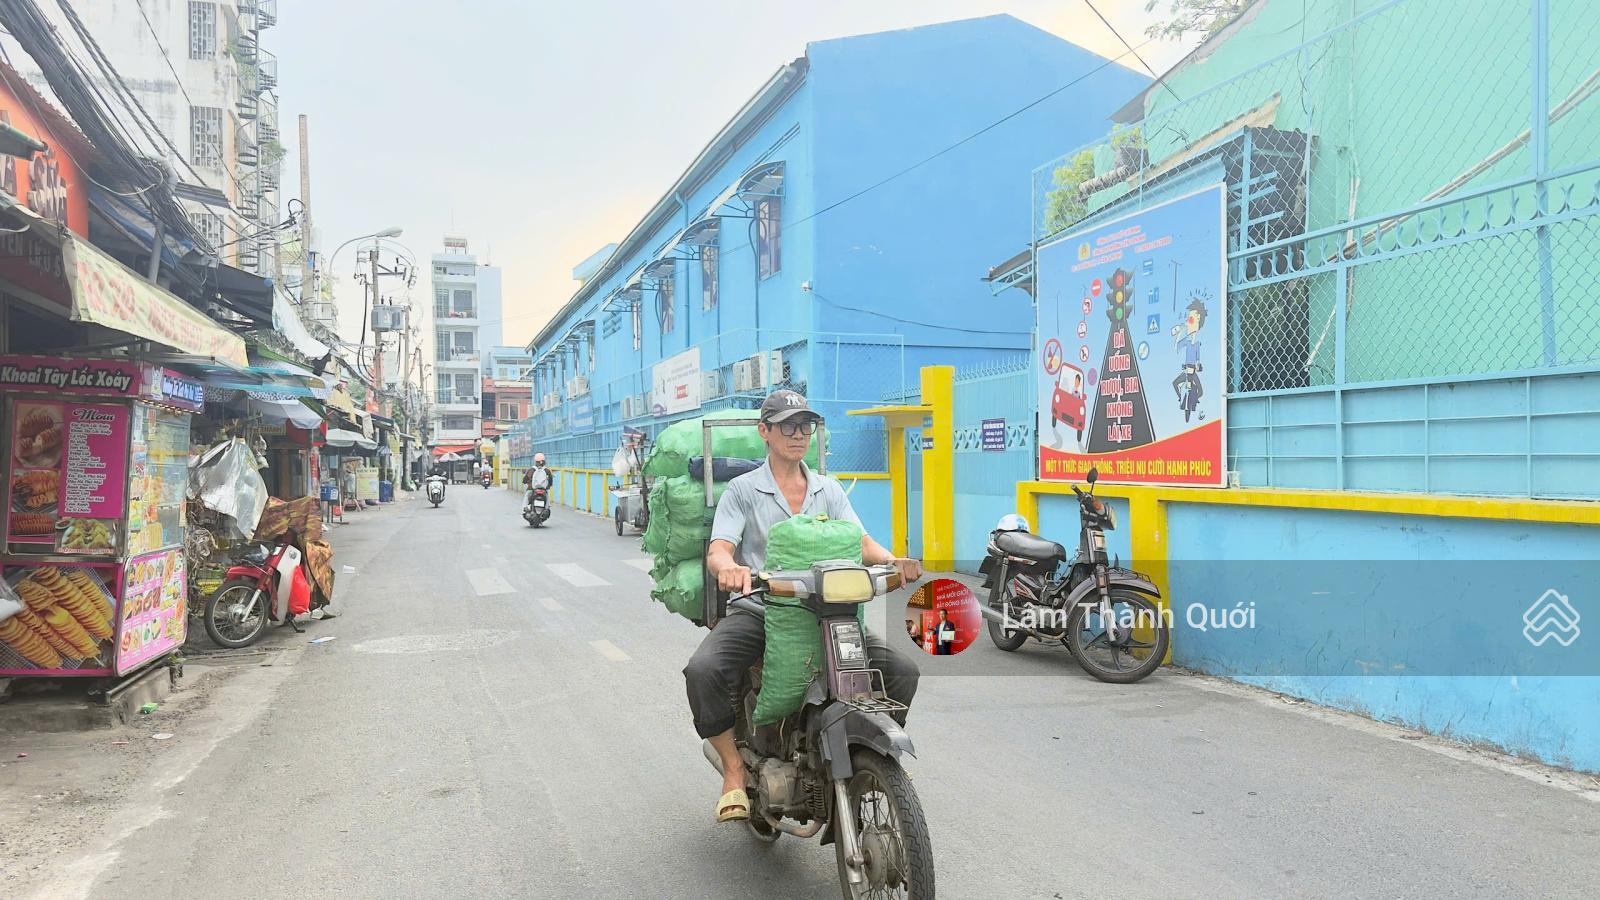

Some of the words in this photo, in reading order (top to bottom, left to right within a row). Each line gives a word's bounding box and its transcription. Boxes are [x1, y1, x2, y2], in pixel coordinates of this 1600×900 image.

[1108, 349, 1131, 372] UỐNG
[1, 366, 42, 384] Khoai
[44, 368, 70, 388] Tây
[70, 366, 94, 386] Lốc
[95, 370, 131, 391] Xoáy
[1124, 376, 1139, 394] BIA
[1106, 400, 1133, 418] KHÔNG
[1121, 424, 1132, 441] XE
[1116, 457, 1135, 478] TRIỆU
[1136, 460, 1147, 478] NỤ
[1147, 457, 1165, 475] CƯỜI
[1166, 460, 1188, 479] HẠNH
[1189, 457, 1212, 477] PHÚC
